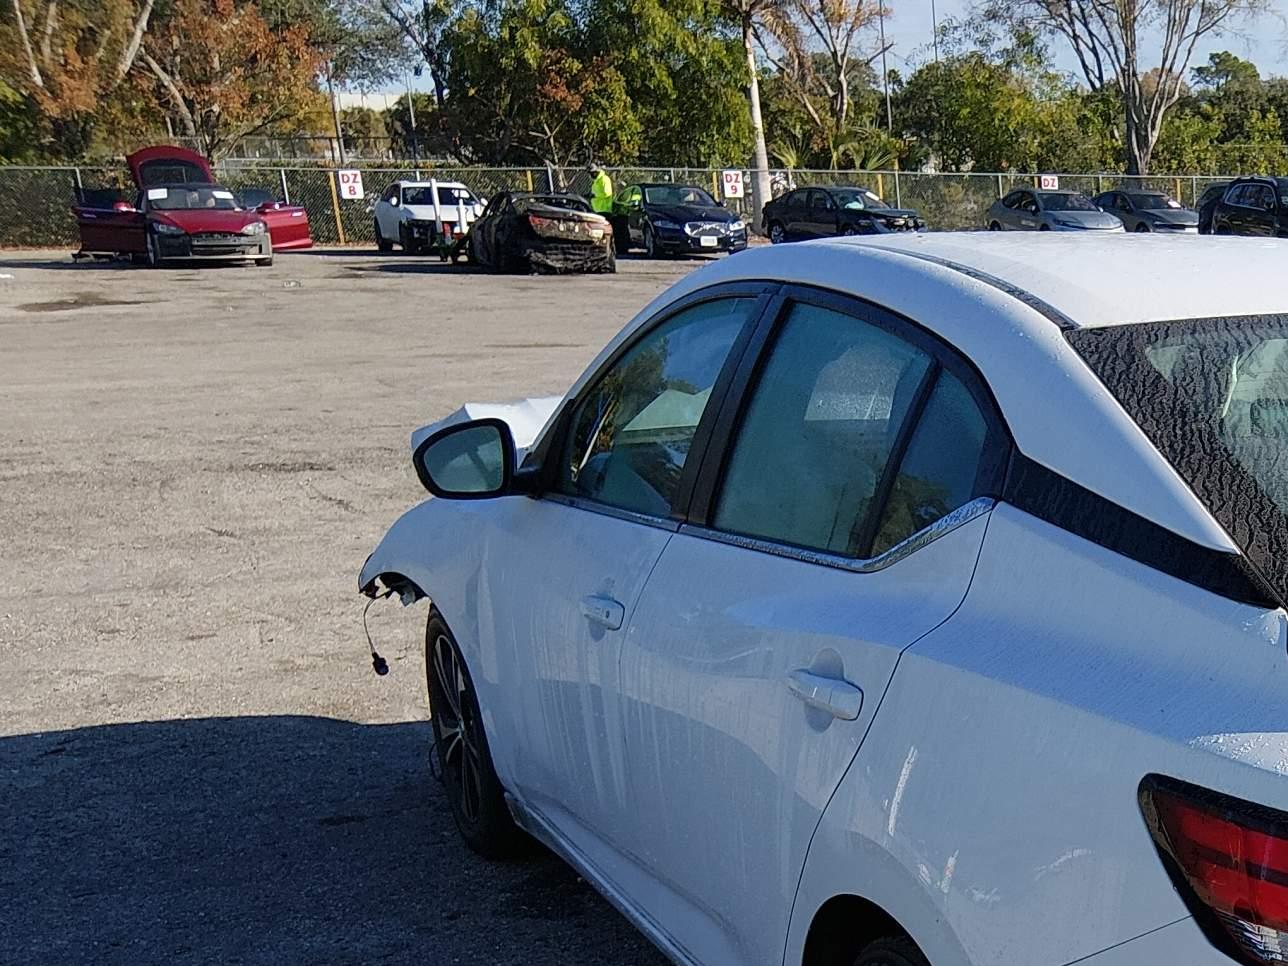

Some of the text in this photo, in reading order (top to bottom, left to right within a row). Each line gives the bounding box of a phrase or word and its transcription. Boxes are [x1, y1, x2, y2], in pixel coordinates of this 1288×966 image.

[341, 173, 360, 184] DZ
[725, 173, 740, 183] DZ
[1043, 178, 1056, 187] DZ
[348, 185, 357, 196] 8
[730, 184, 738, 195] 9
